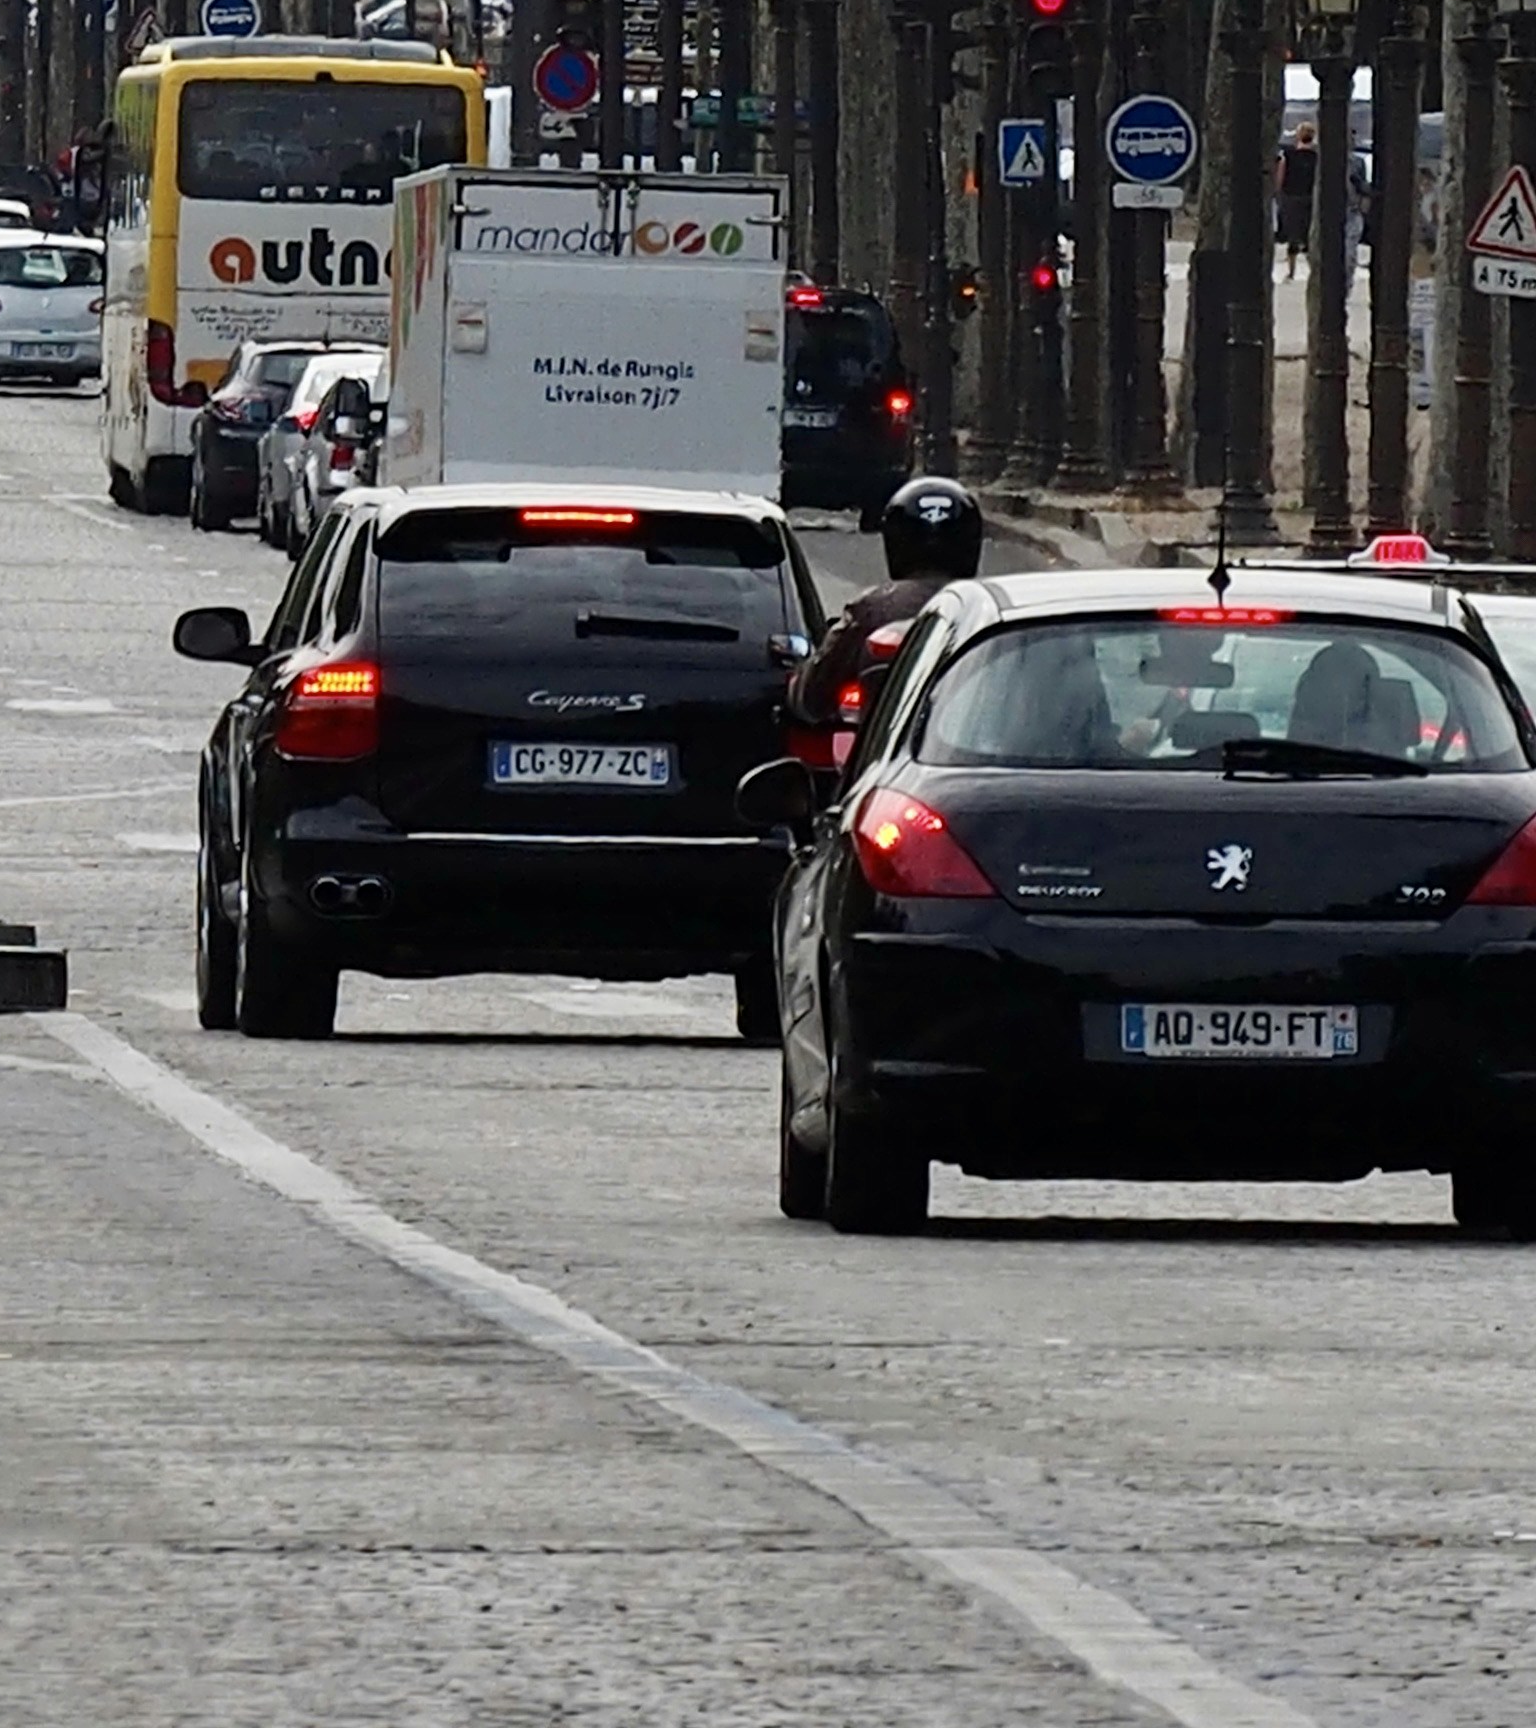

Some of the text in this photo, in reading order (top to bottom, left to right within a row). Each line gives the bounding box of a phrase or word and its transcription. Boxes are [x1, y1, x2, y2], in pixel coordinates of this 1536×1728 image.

[210, 227, 392, 286] autn
[1478, 265, 1489, 285] A
[1497, 268, 1517, 289] 75
[596, 358, 621, 377] de
[545, 385, 636, 405] Livraison
[515, 748, 648, 776] CG-977-ZC
[1153, 1010, 1327, 1047] AQ-949-FT
